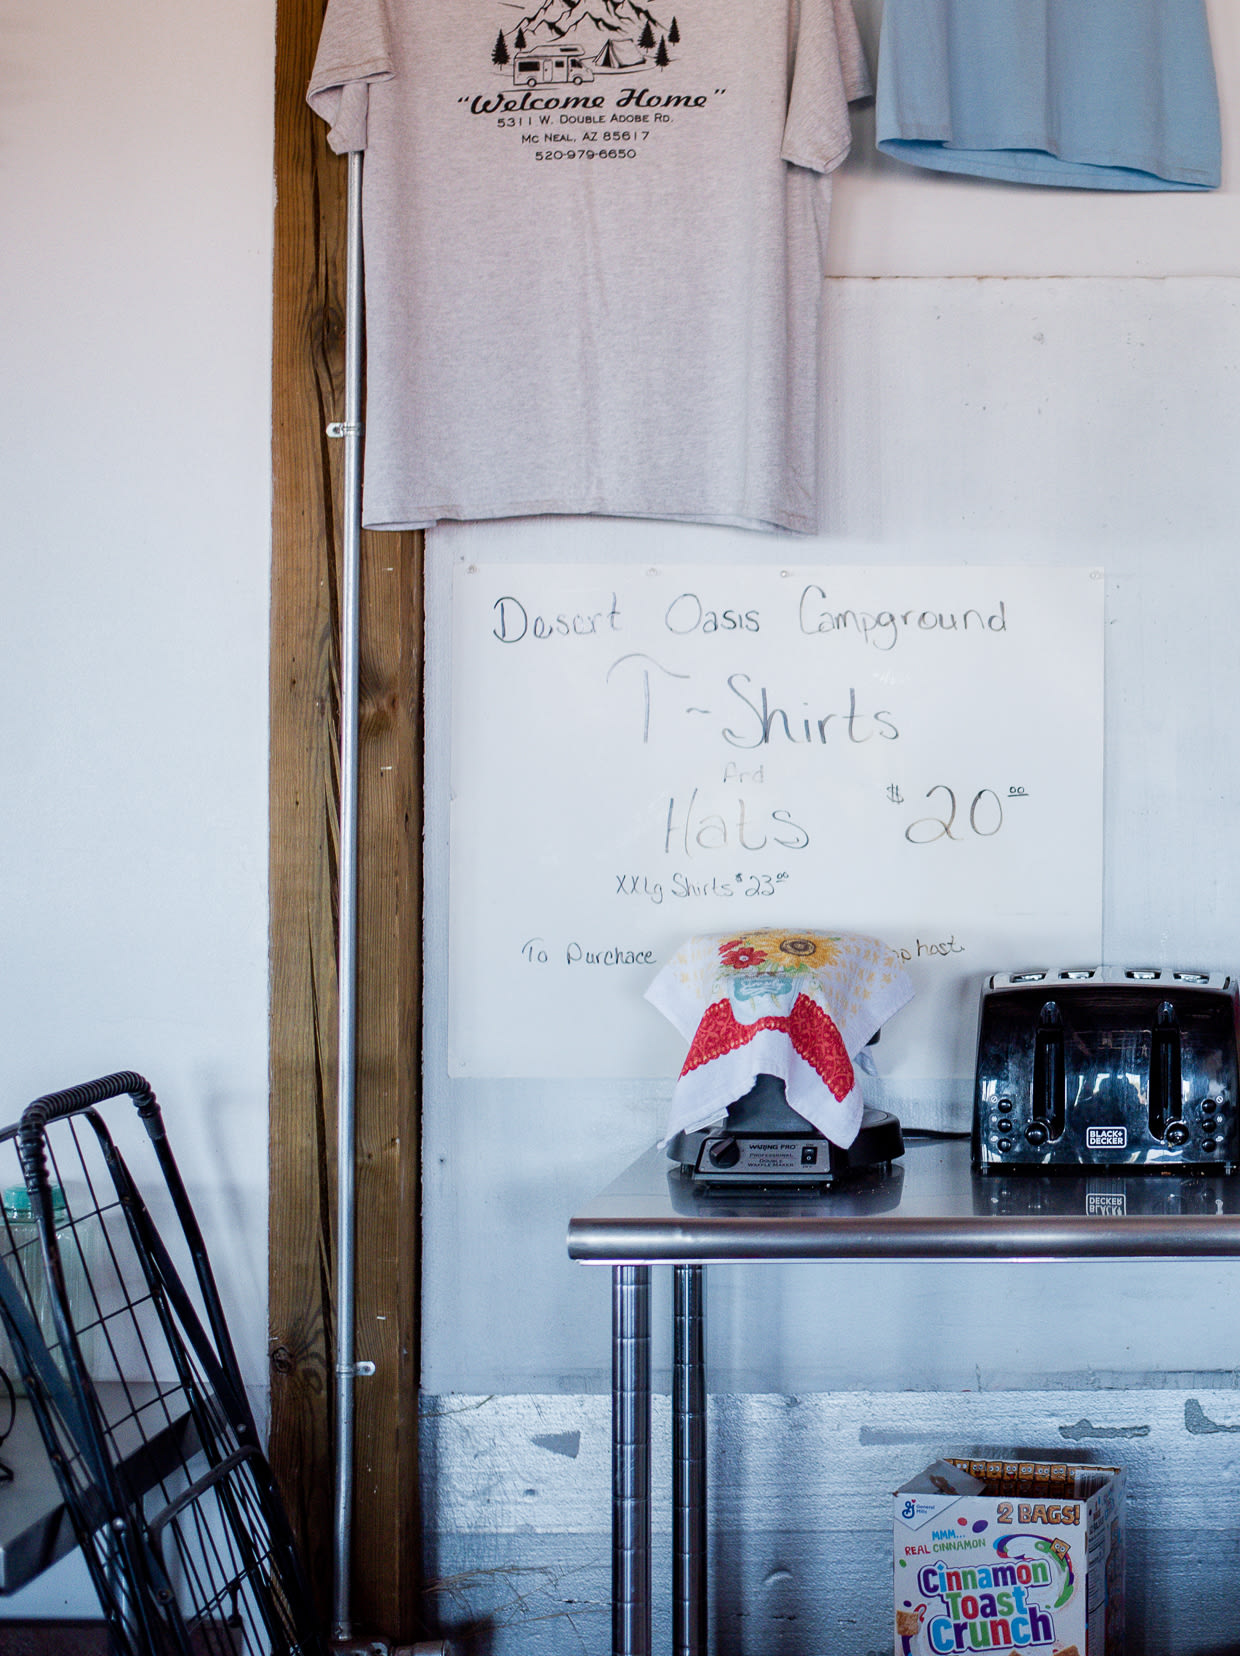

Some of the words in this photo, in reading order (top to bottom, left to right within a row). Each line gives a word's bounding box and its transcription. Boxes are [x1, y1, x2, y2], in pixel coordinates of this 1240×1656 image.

[497, 117, 532, 128] 5311
[560, 114, 605, 124] DOUBLE
[610, 114, 649, 123] ADOBE
[582, 132, 598, 142] AZ
[603, 131, 650, 142] 85617
[536, 150, 636, 161] 520-979-6650
[493, 592, 623, 643] Desert
[665, 593, 760, 634] Oasis
[800, 585, 1007, 651] Campground
[666, 788, 810, 857] Hats
[672, 873, 734, 897] Shirts
[522, 937, 548, 963] To
[996, 1503, 1013, 1524] 2
[1018, 1504, 1081, 1526] BAGS!
[905, 1544, 931, 1556] REAL
[933, 1539, 986, 1553] CINNAMON
[922, 1562, 1049, 1594] Cinnamon
[946, 1587, 1028, 1621] Toast
[932, 1606, 1053, 1651] Crunch
